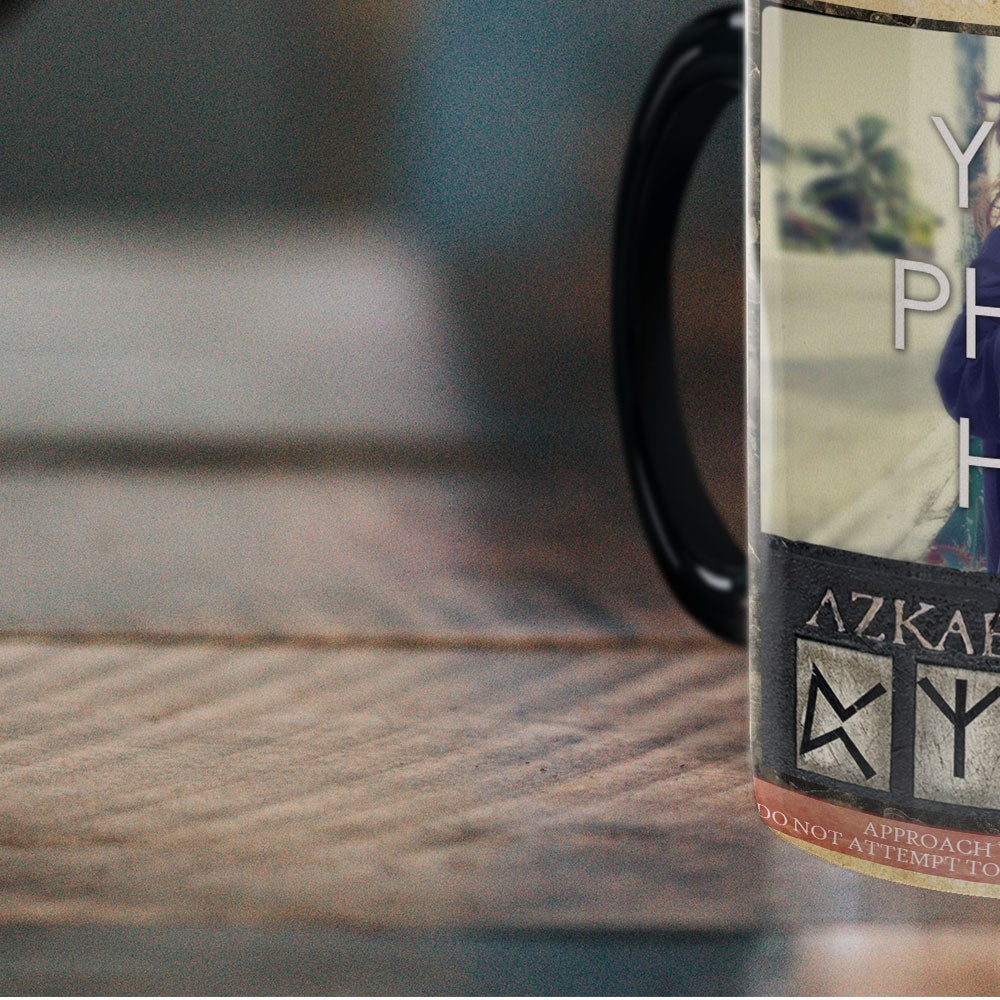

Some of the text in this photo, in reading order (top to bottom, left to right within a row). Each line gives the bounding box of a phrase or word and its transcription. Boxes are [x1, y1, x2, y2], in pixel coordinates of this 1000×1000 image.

[757, 803, 788, 826] DO
[793, 818, 843, 846] NOT
[848, 836, 960, 872] ATTEMPT
[965, 859, 1000, 877] TO
[863, 821, 991, 857] APPROACH
